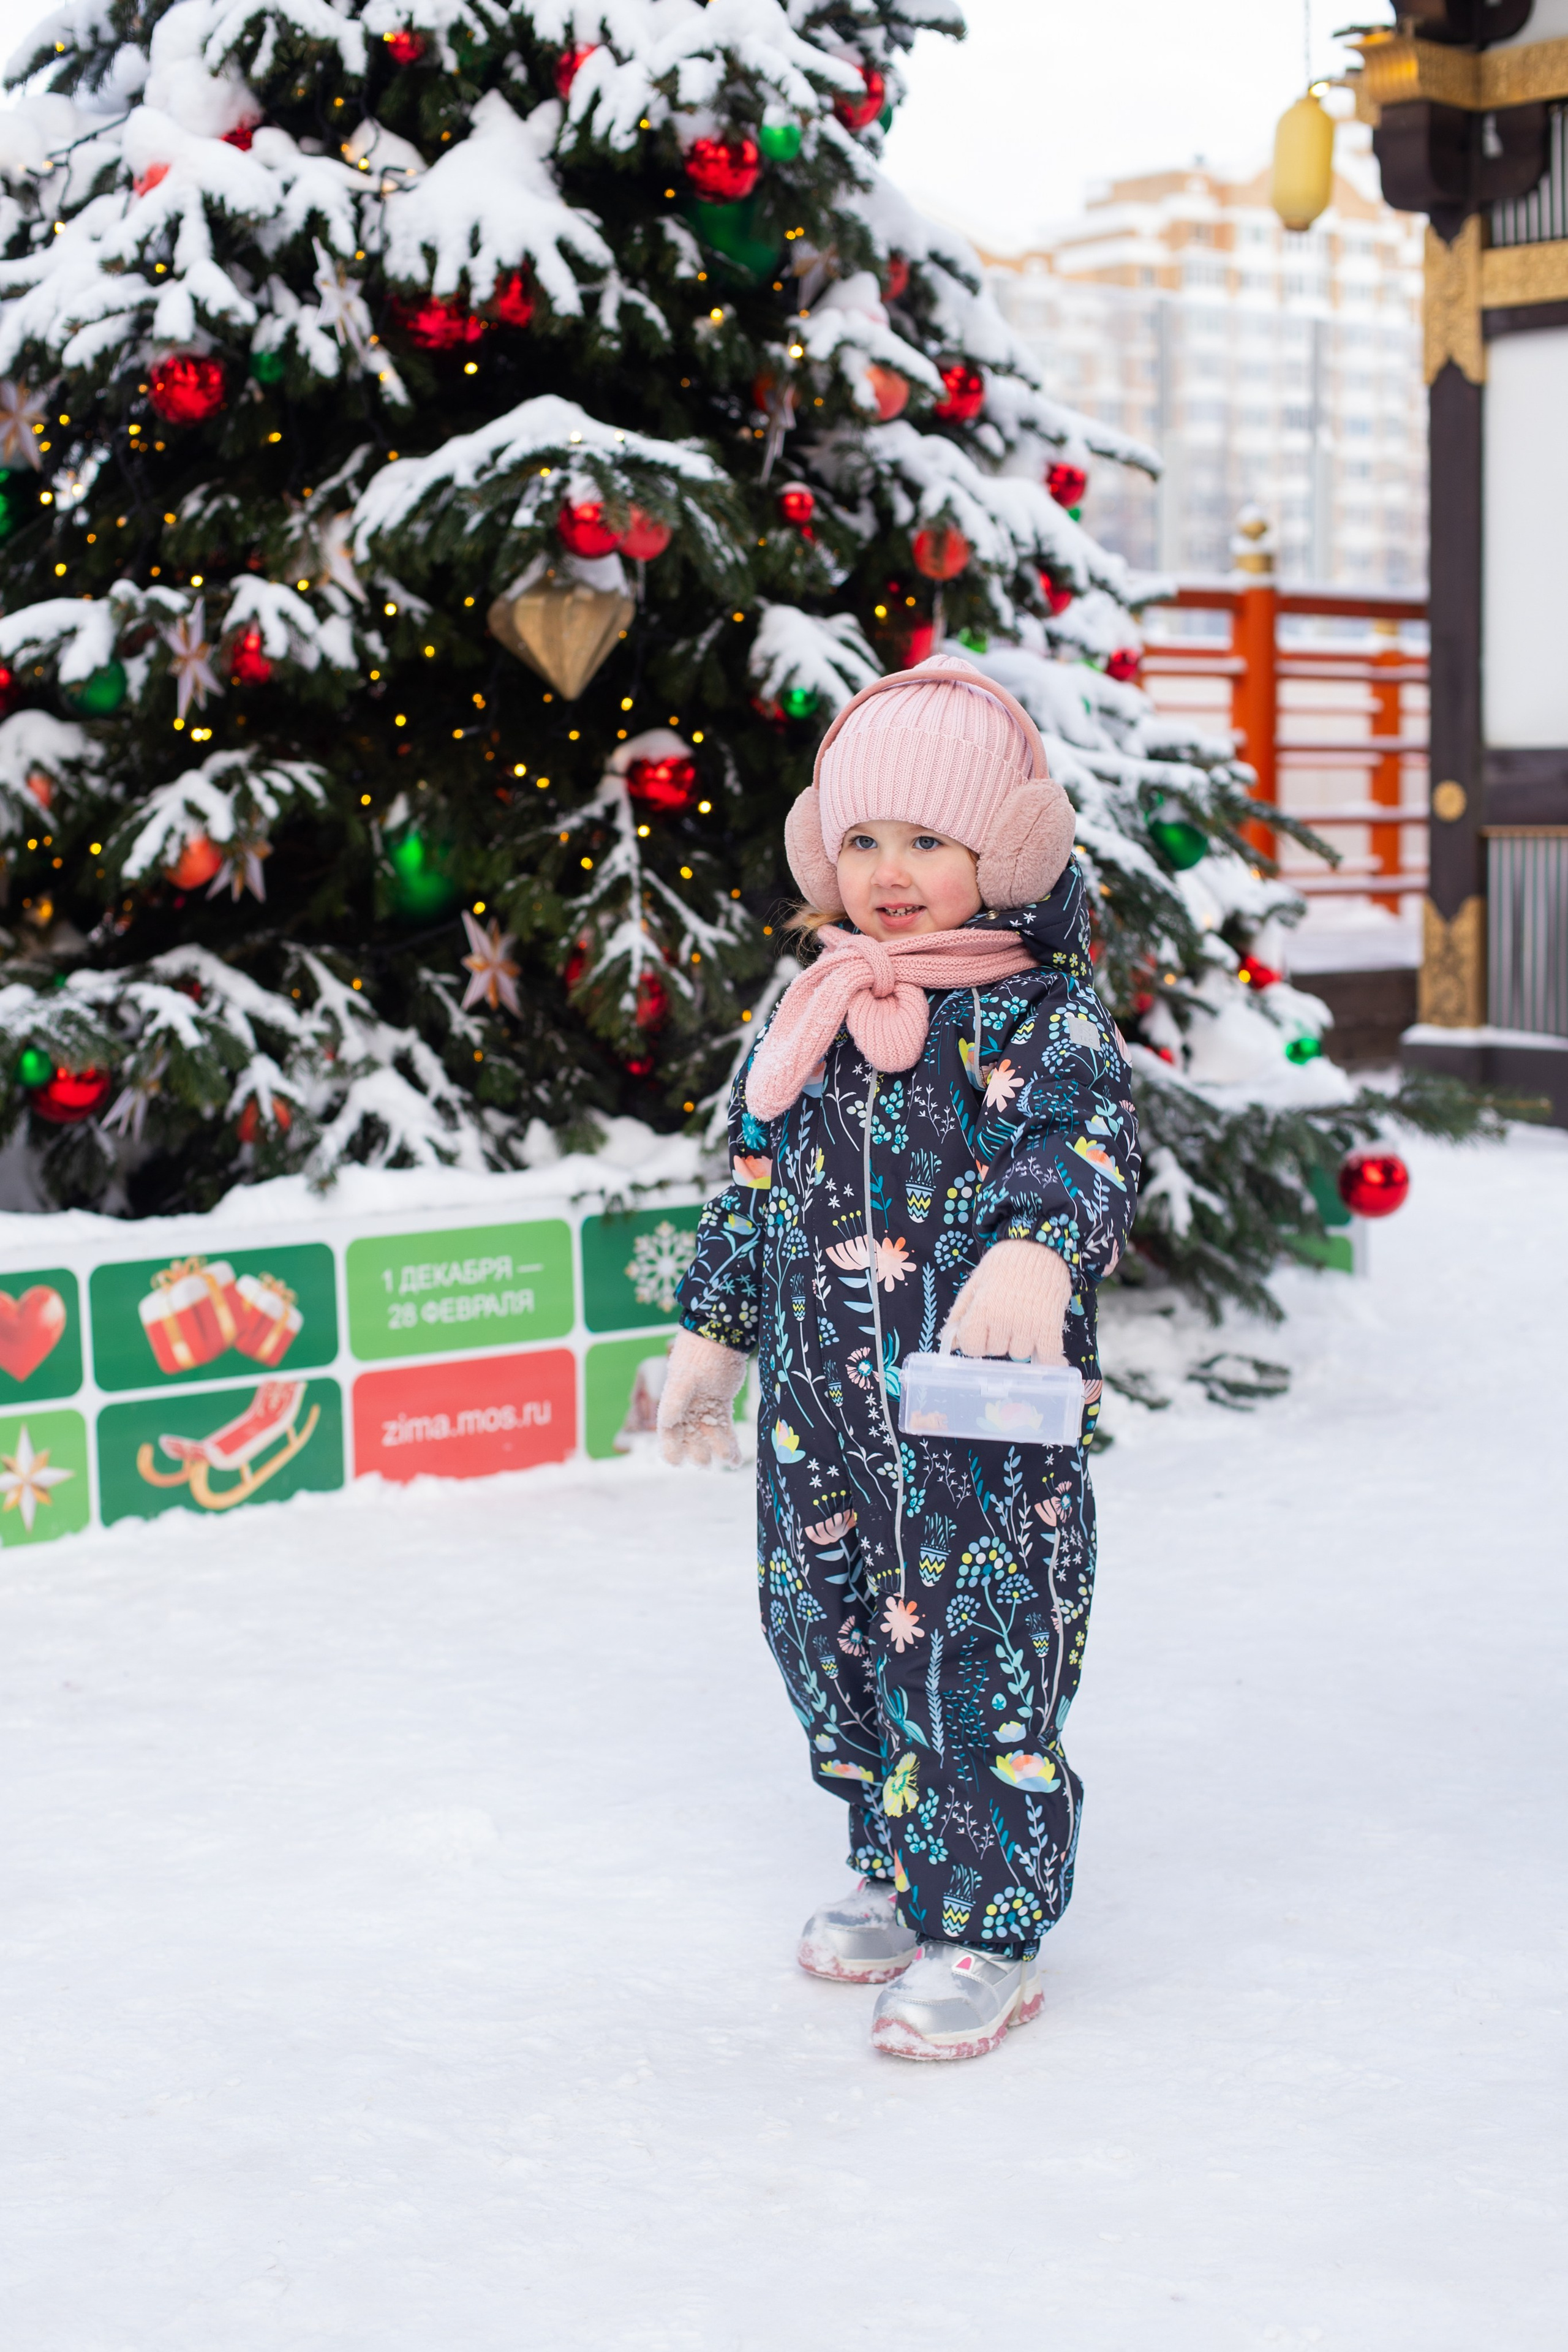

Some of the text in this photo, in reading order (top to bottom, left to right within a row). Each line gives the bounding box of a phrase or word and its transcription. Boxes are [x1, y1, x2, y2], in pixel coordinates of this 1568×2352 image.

[381, 1268, 394, 1293] 1
[399, 1255, 513, 1295] ДЕКАБРЯ
[388, 1288, 535, 1330] 28 ФЕВРАЛЯ
[381, 1400, 552, 1447] zima.mos.ru
